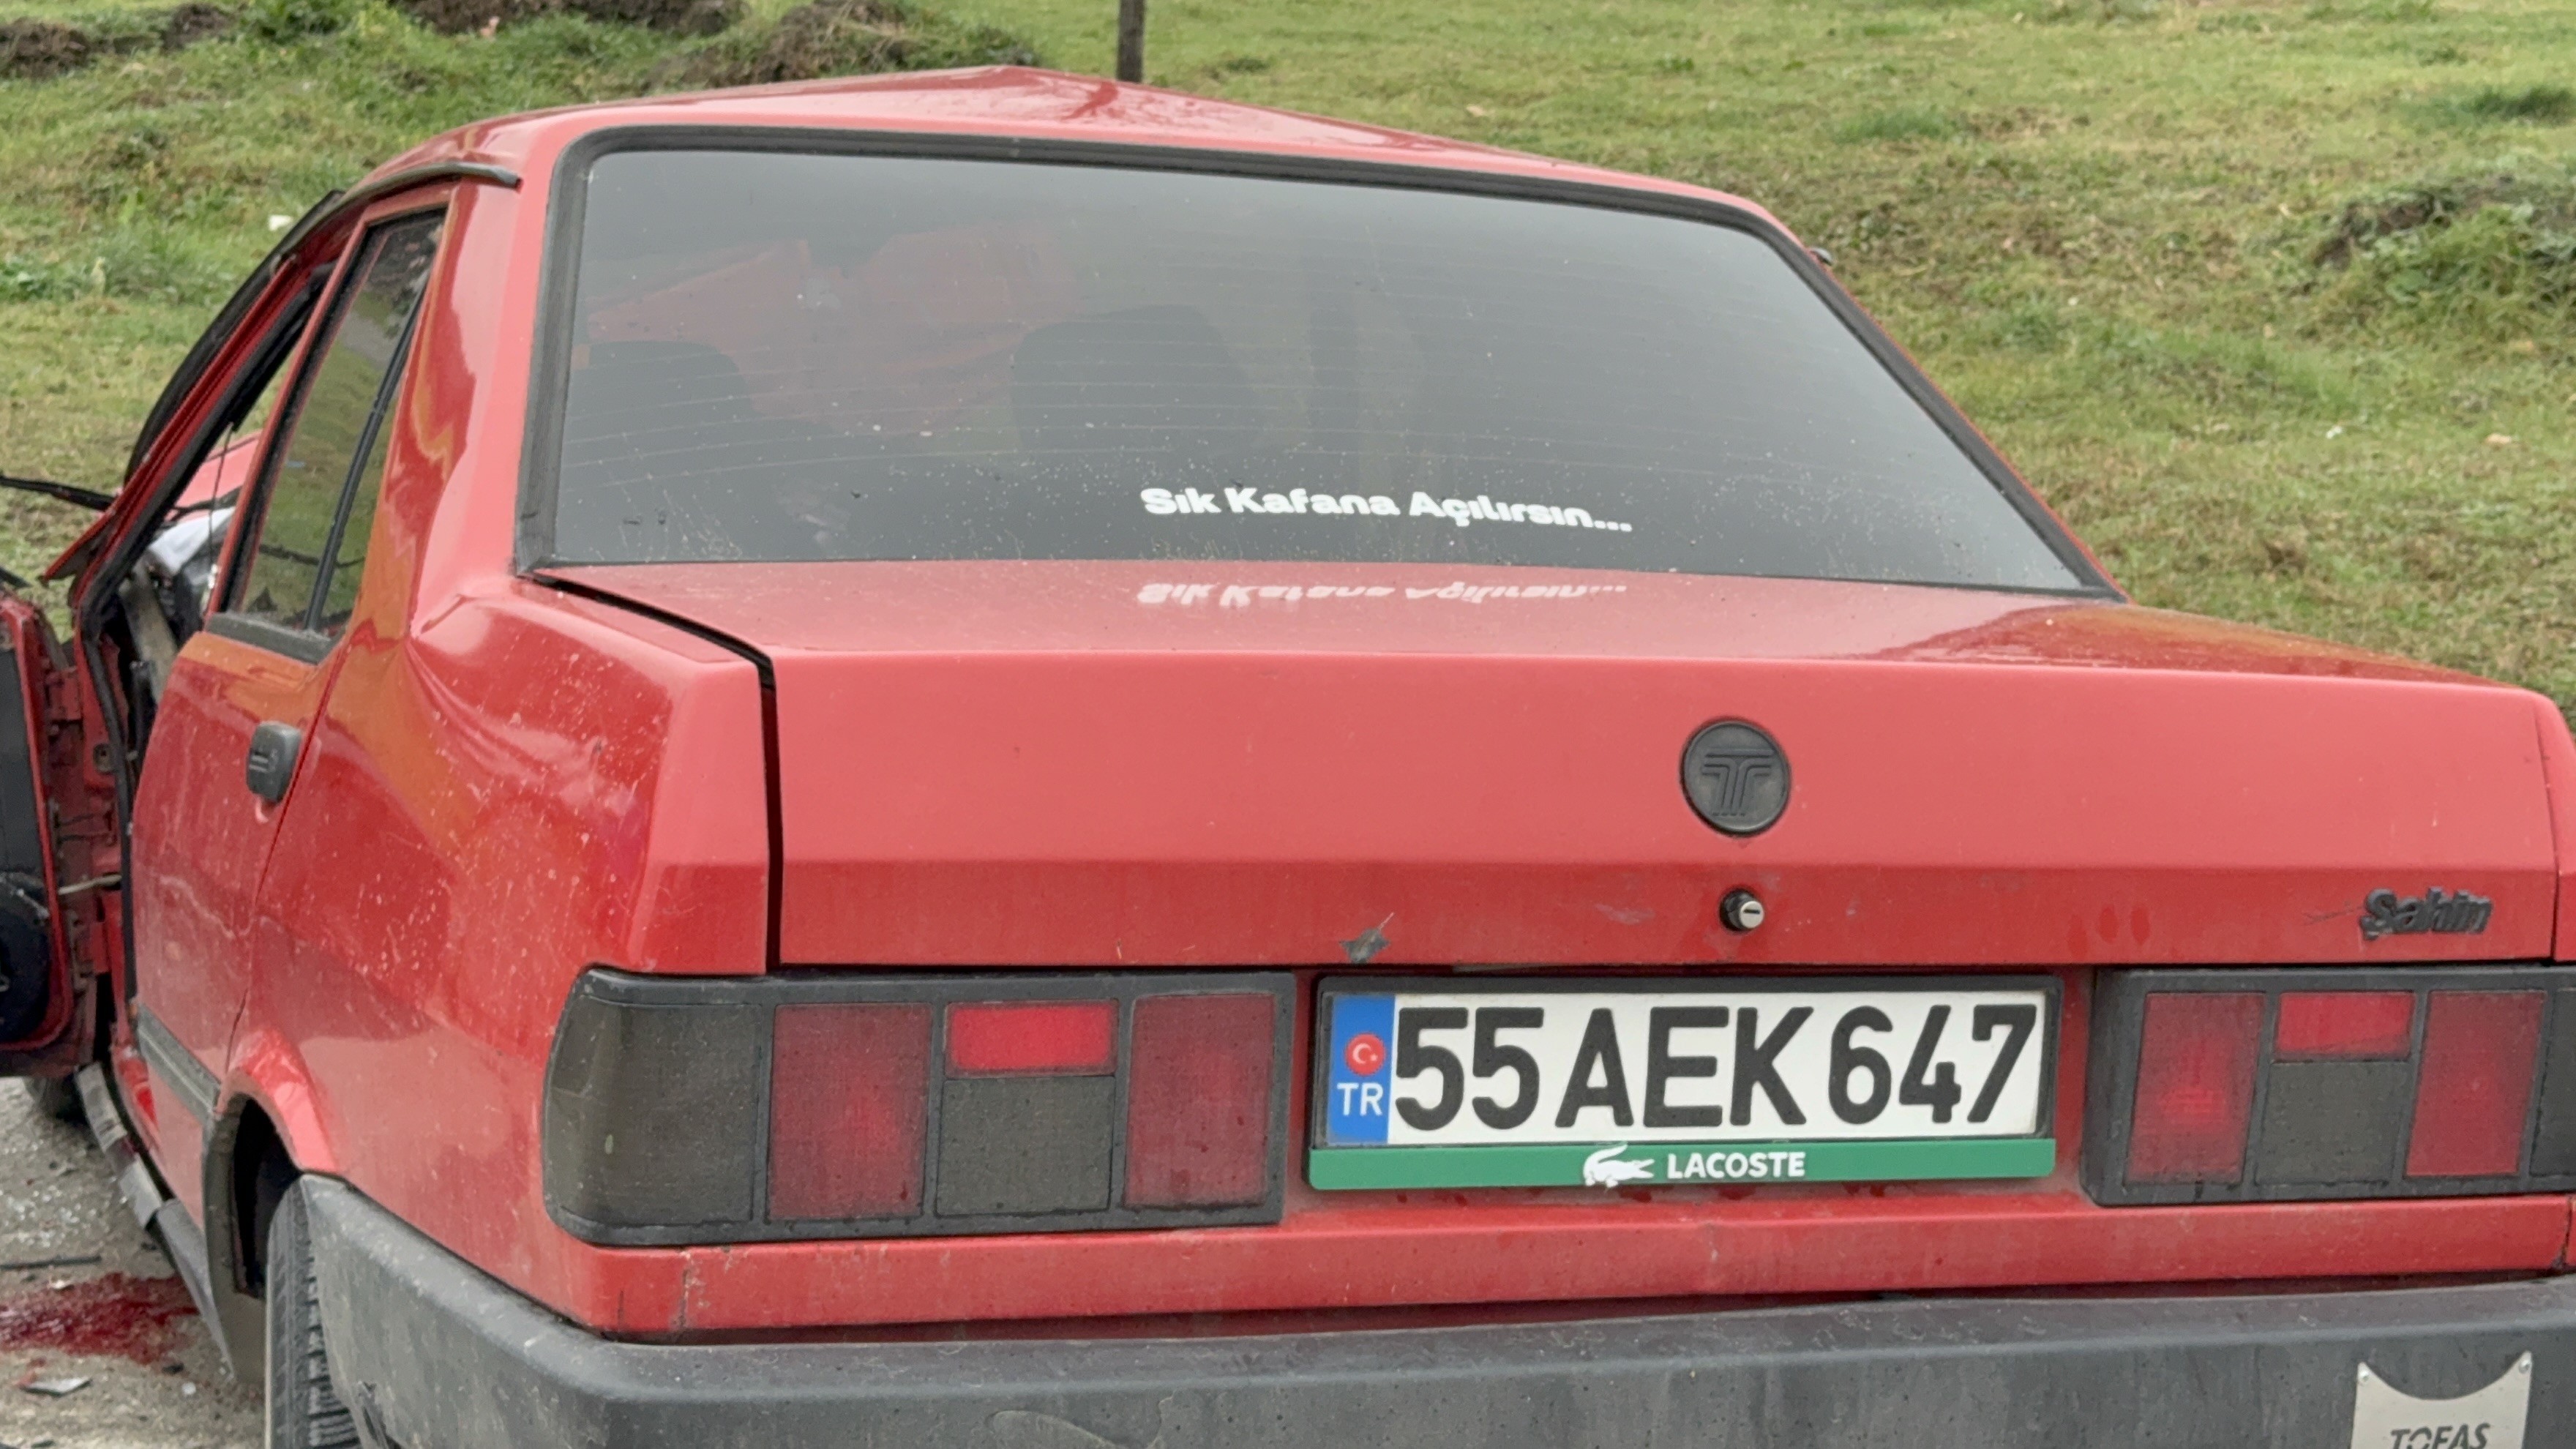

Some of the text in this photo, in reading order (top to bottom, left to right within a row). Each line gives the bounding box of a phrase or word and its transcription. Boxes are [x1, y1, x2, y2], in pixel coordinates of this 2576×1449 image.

[1140, 487, 1222, 514] Sık
[1224, 487, 1401, 515] Kafana
[1395, 1003, 2037, 1131] 55 AEK 647
[1336, 1082, 1384, 1116] TR
[1667, 1151, 1806, 1179] LACOSTE
